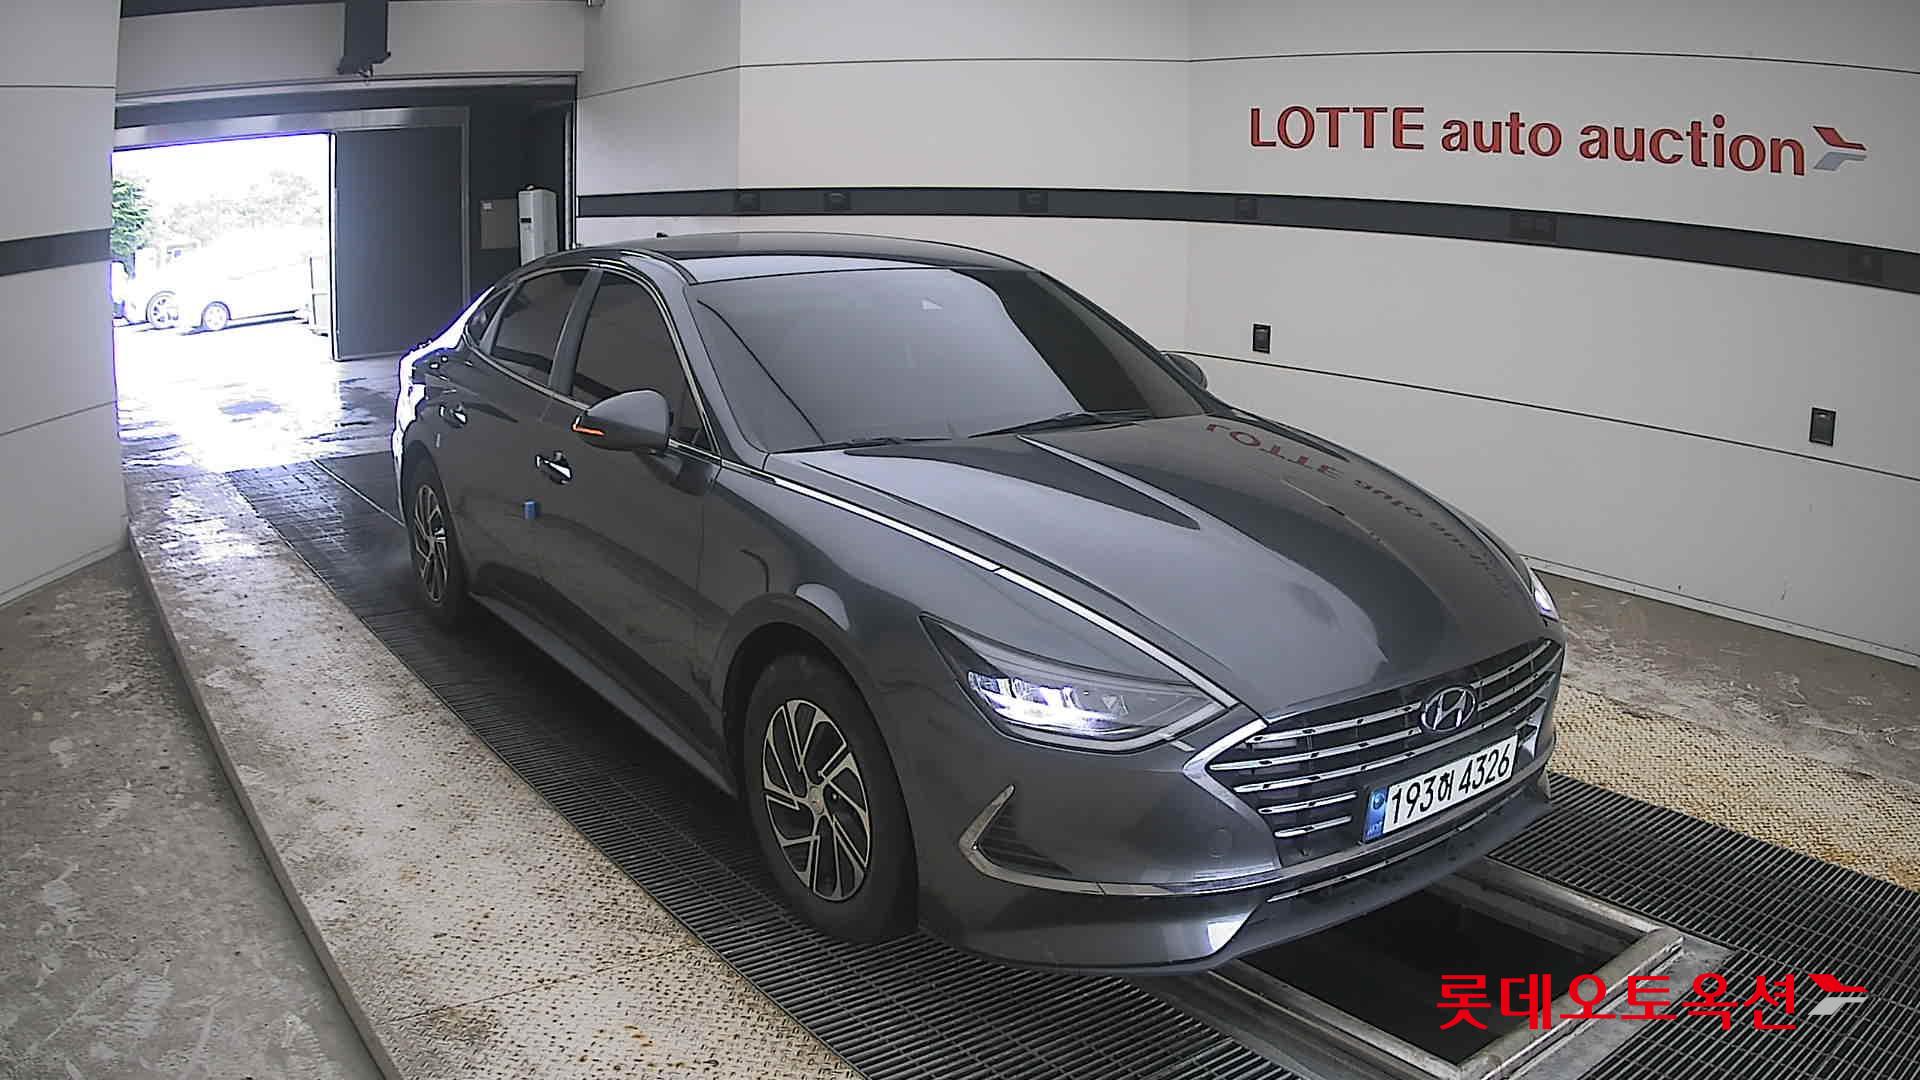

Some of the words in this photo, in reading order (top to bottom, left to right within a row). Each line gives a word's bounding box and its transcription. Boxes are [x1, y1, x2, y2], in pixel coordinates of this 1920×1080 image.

[1250, 105, 1425, 151] LOTTE
[1441, 112, 1564, 157] auto
[1579, 114, 1807, 177] auction
[1391, 769, 1455, 825] 193허
[1458, 743, 1511, 794] 4326
